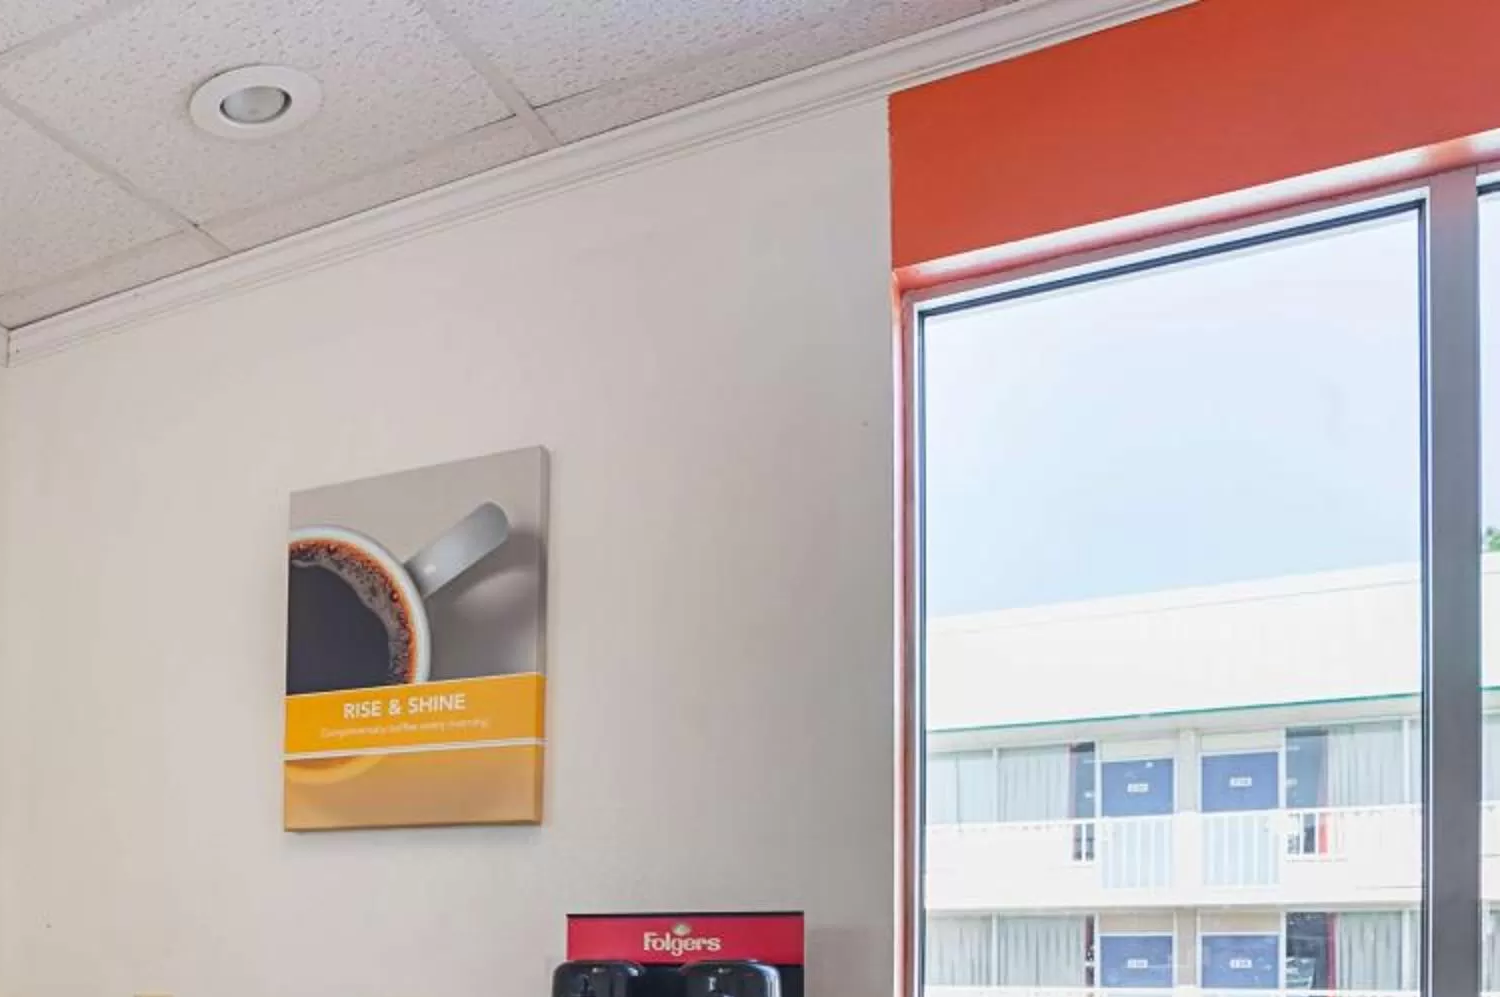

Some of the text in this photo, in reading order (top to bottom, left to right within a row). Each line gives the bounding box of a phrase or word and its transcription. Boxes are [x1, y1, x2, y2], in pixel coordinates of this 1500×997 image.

[343, 693, 466, 719] RISE & SHINE
[643, 931, 721, 957] Folgers
